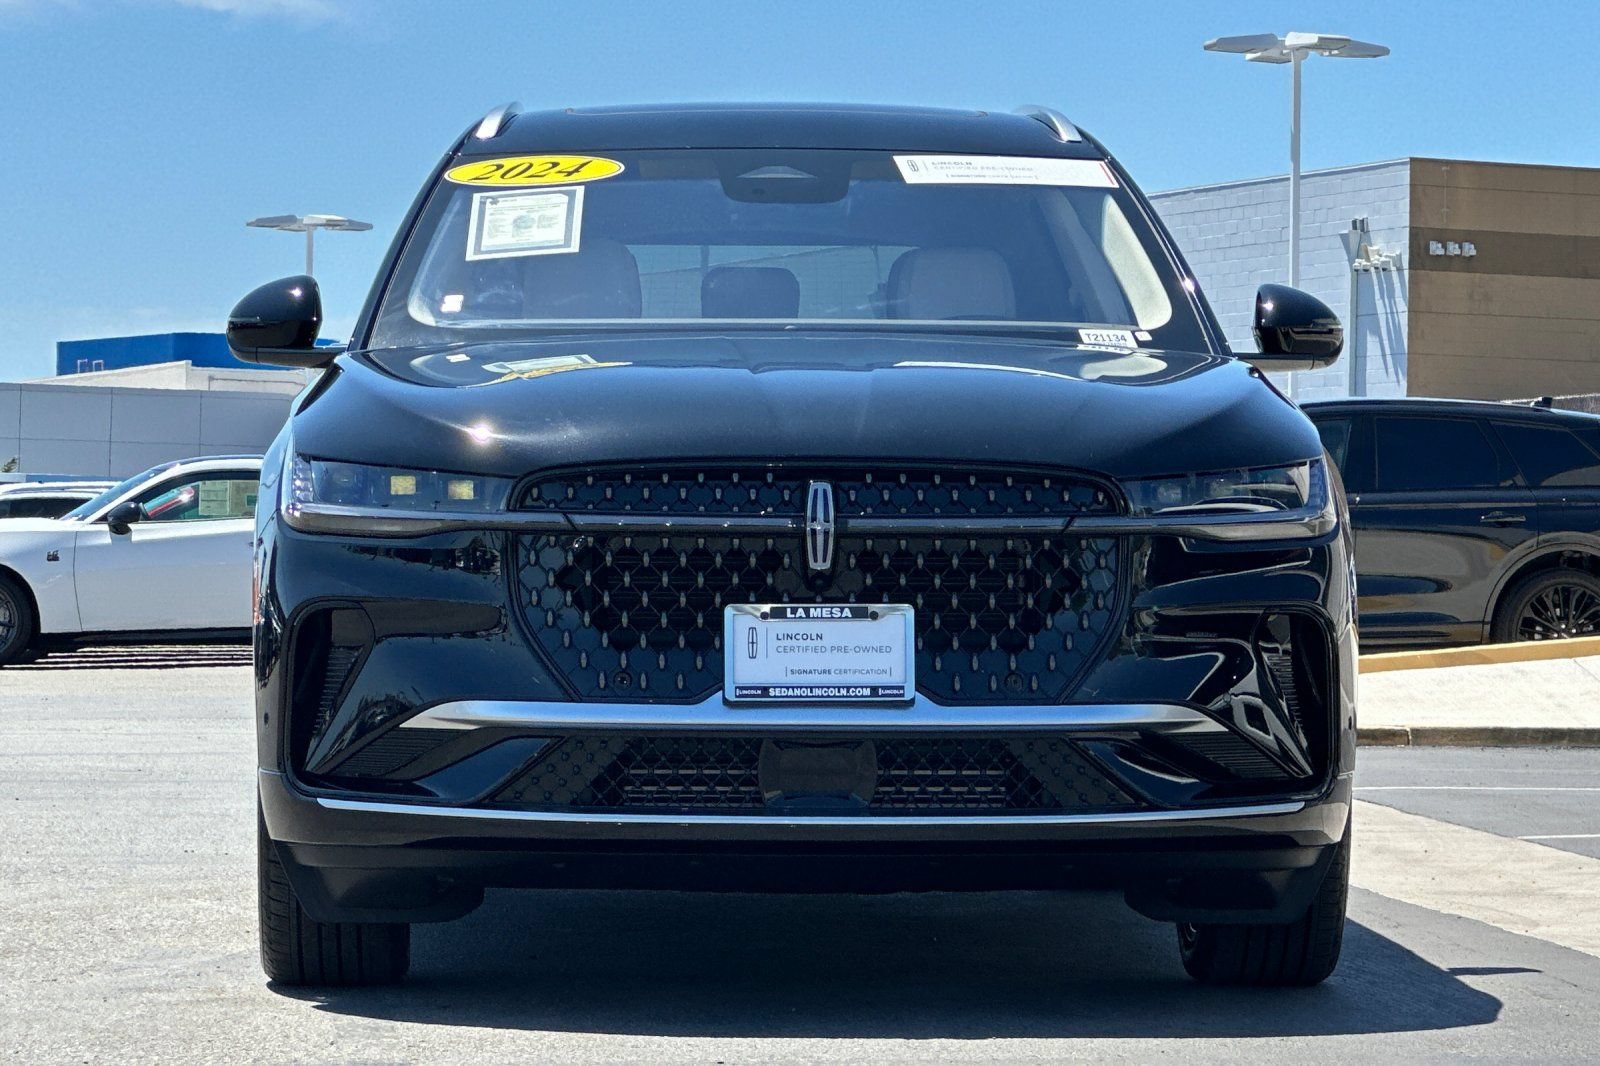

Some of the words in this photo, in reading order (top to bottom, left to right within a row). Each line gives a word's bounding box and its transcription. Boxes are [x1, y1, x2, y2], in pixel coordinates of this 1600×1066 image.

[467, 160, 593, 181] 2024
[786, 607, 806, 618] LA
[809, 607, 853, 618] MESA
[776, 633, 823, 641] LINCOLN
[775, 645, 827, 654] CERTIFIED
[830, 645, 892, 654] PRE-OWNED
[790, 668, 832, 676] SIGNATURE
[833, 668, 888, 676] CERTIFICATION
[768, 687, 871, 697] SEDANOLINCOLN.COM
